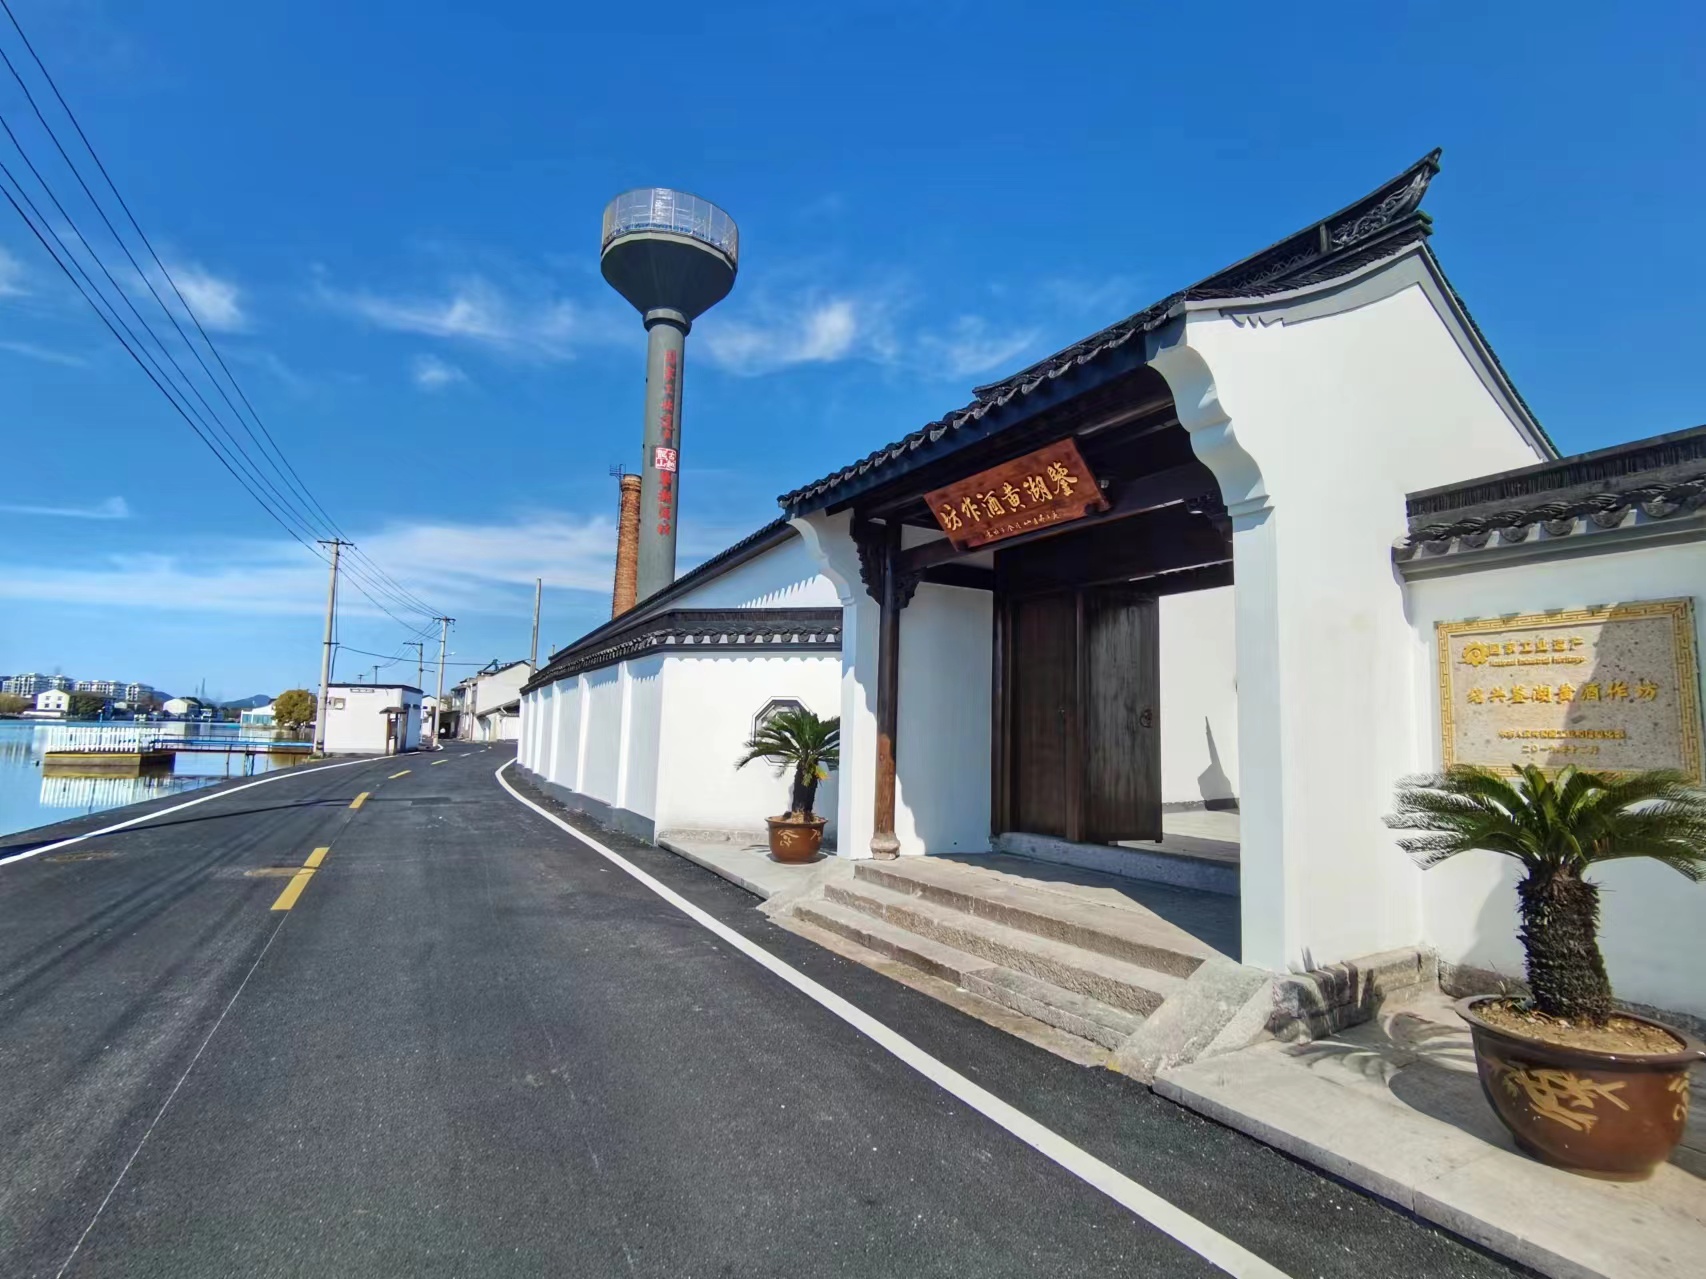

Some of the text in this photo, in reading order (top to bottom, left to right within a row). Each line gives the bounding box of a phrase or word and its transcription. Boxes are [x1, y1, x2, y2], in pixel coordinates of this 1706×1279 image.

[1489, 637, 1584, 655] 国家工业遗产
[1467, 681, 1658, 704] 绍兴鉴湖黄酒作坊
